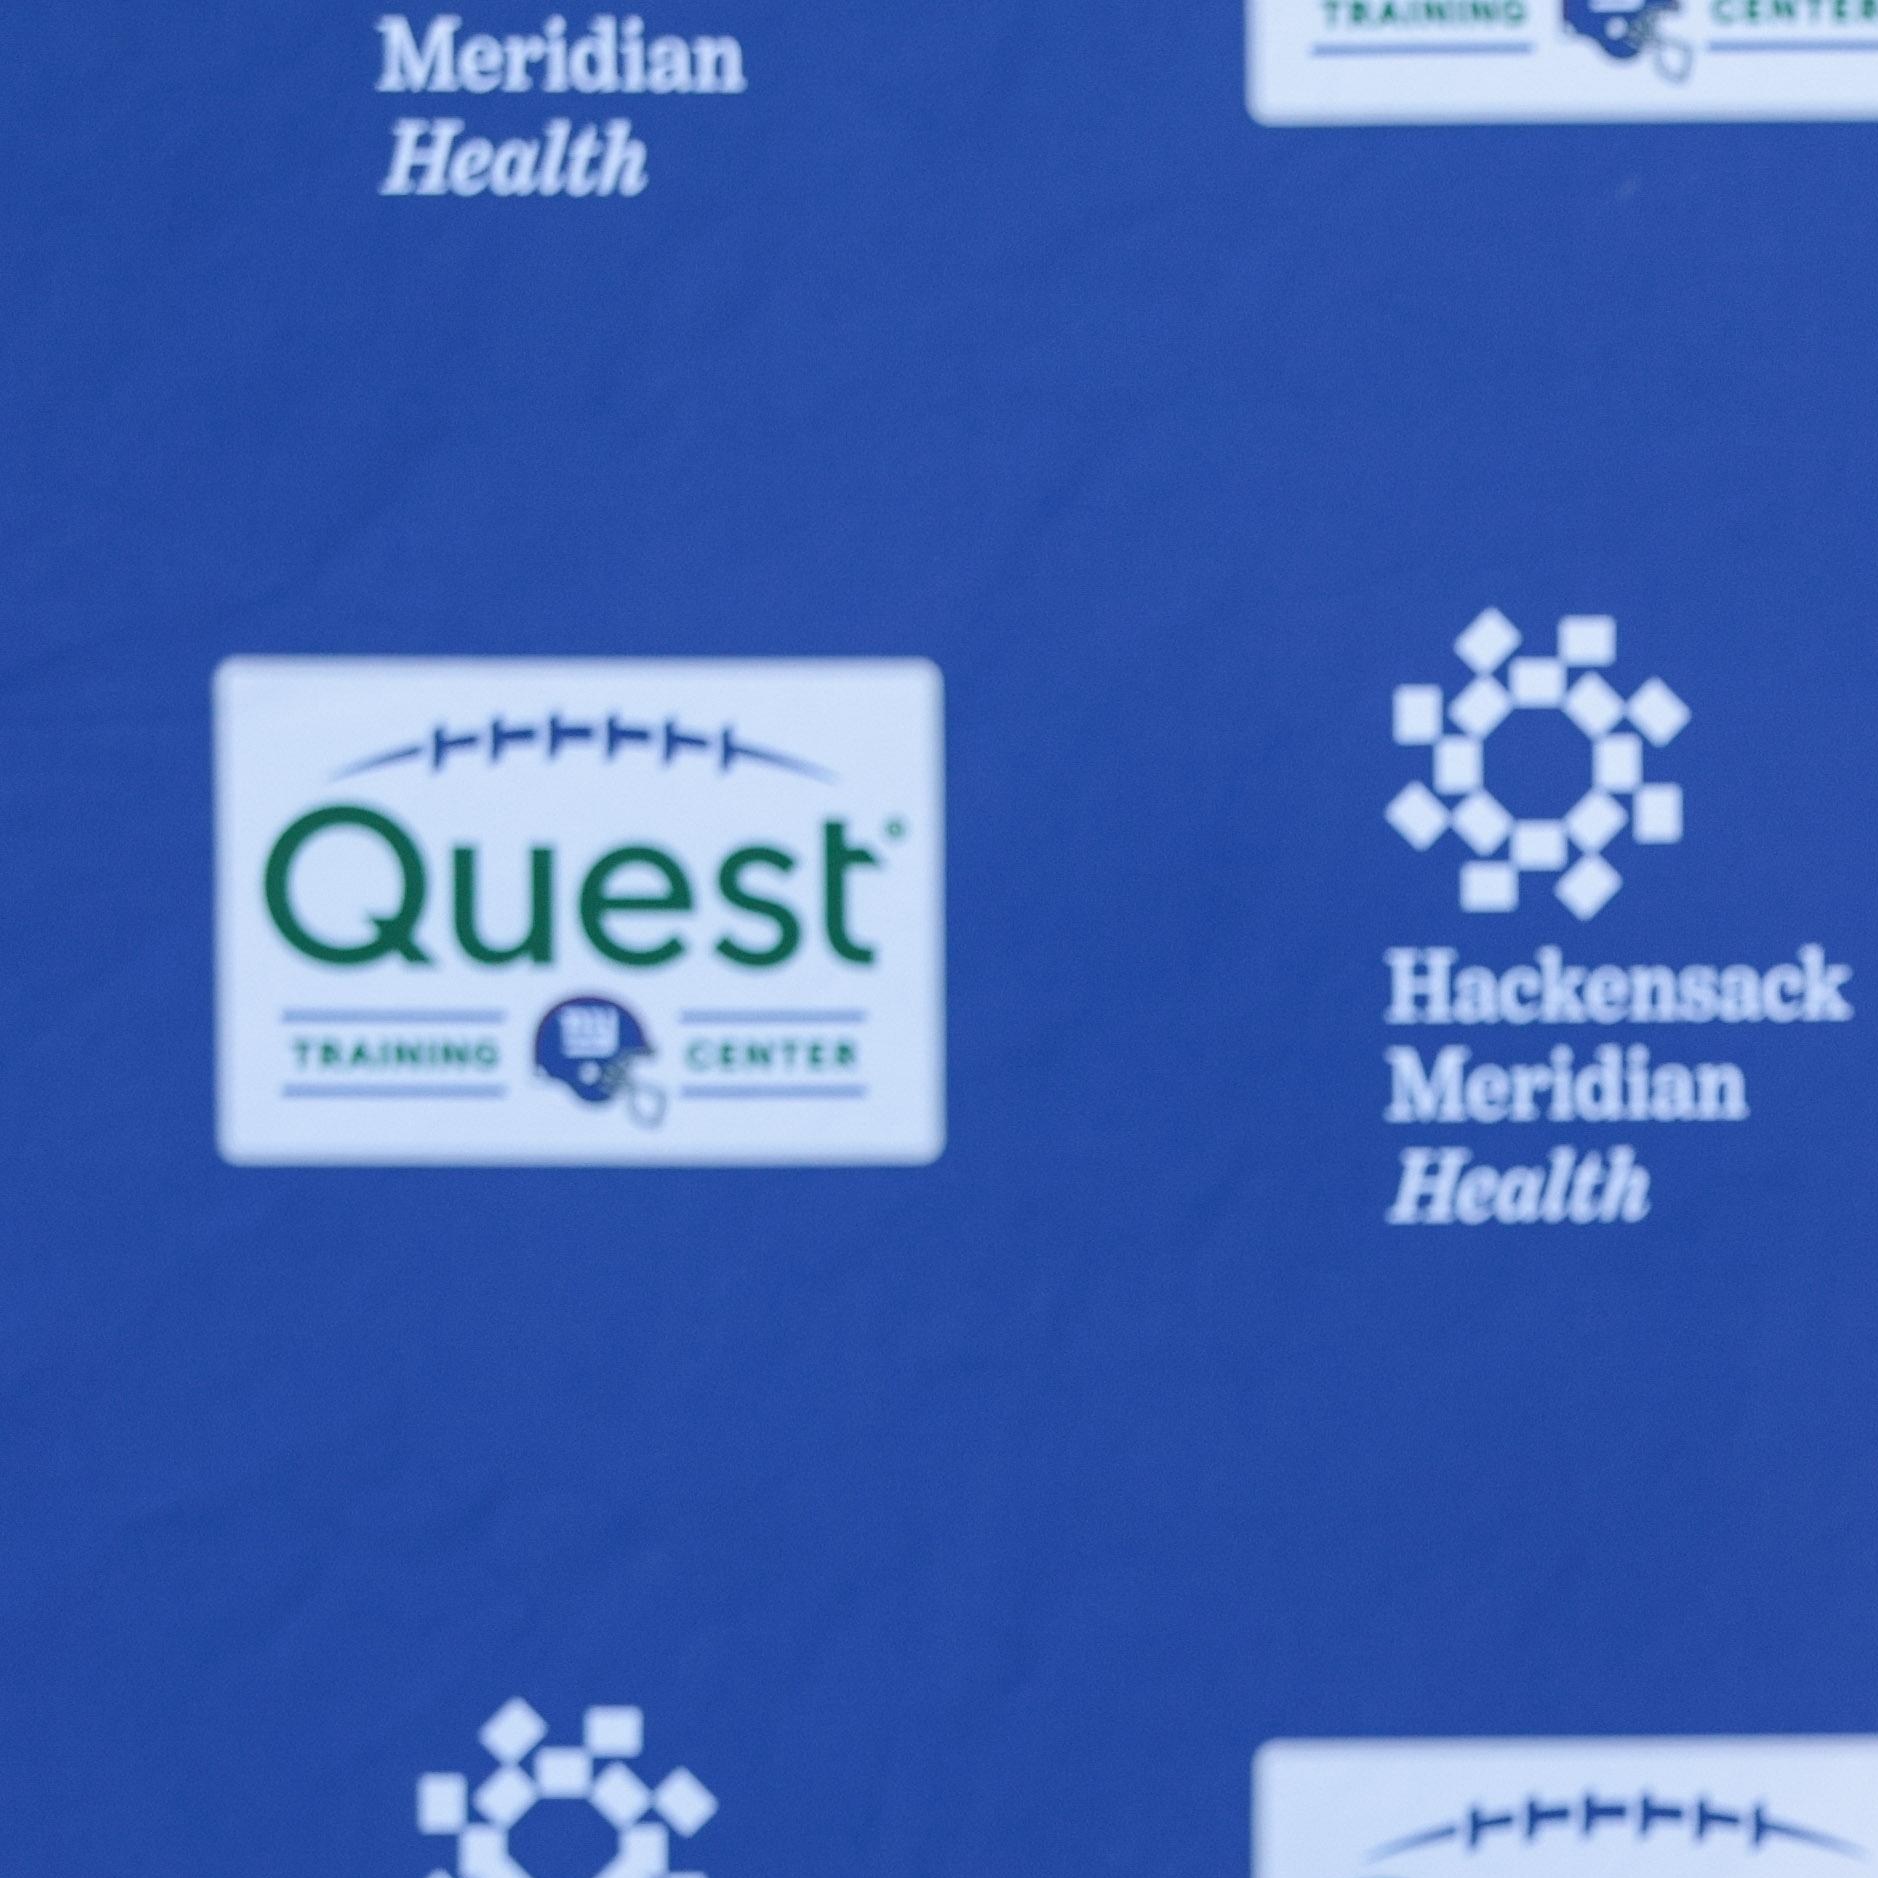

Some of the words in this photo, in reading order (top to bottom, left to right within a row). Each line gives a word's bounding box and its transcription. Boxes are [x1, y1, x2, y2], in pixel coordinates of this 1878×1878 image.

[377, 15, 747, 93] Meridian
[381, 118, 648, 197] Health
[262, 802, 880, 968] Quest
[1385, 943, 1854, 1024] Hackensack
[293, 1036, 500, 1072] TRAINING
[685, 1036, 858, 1072] CENTER
[1385, 1043, 1750, 1122] Meridian
[1387, 1145, 1650, 1224] Health
